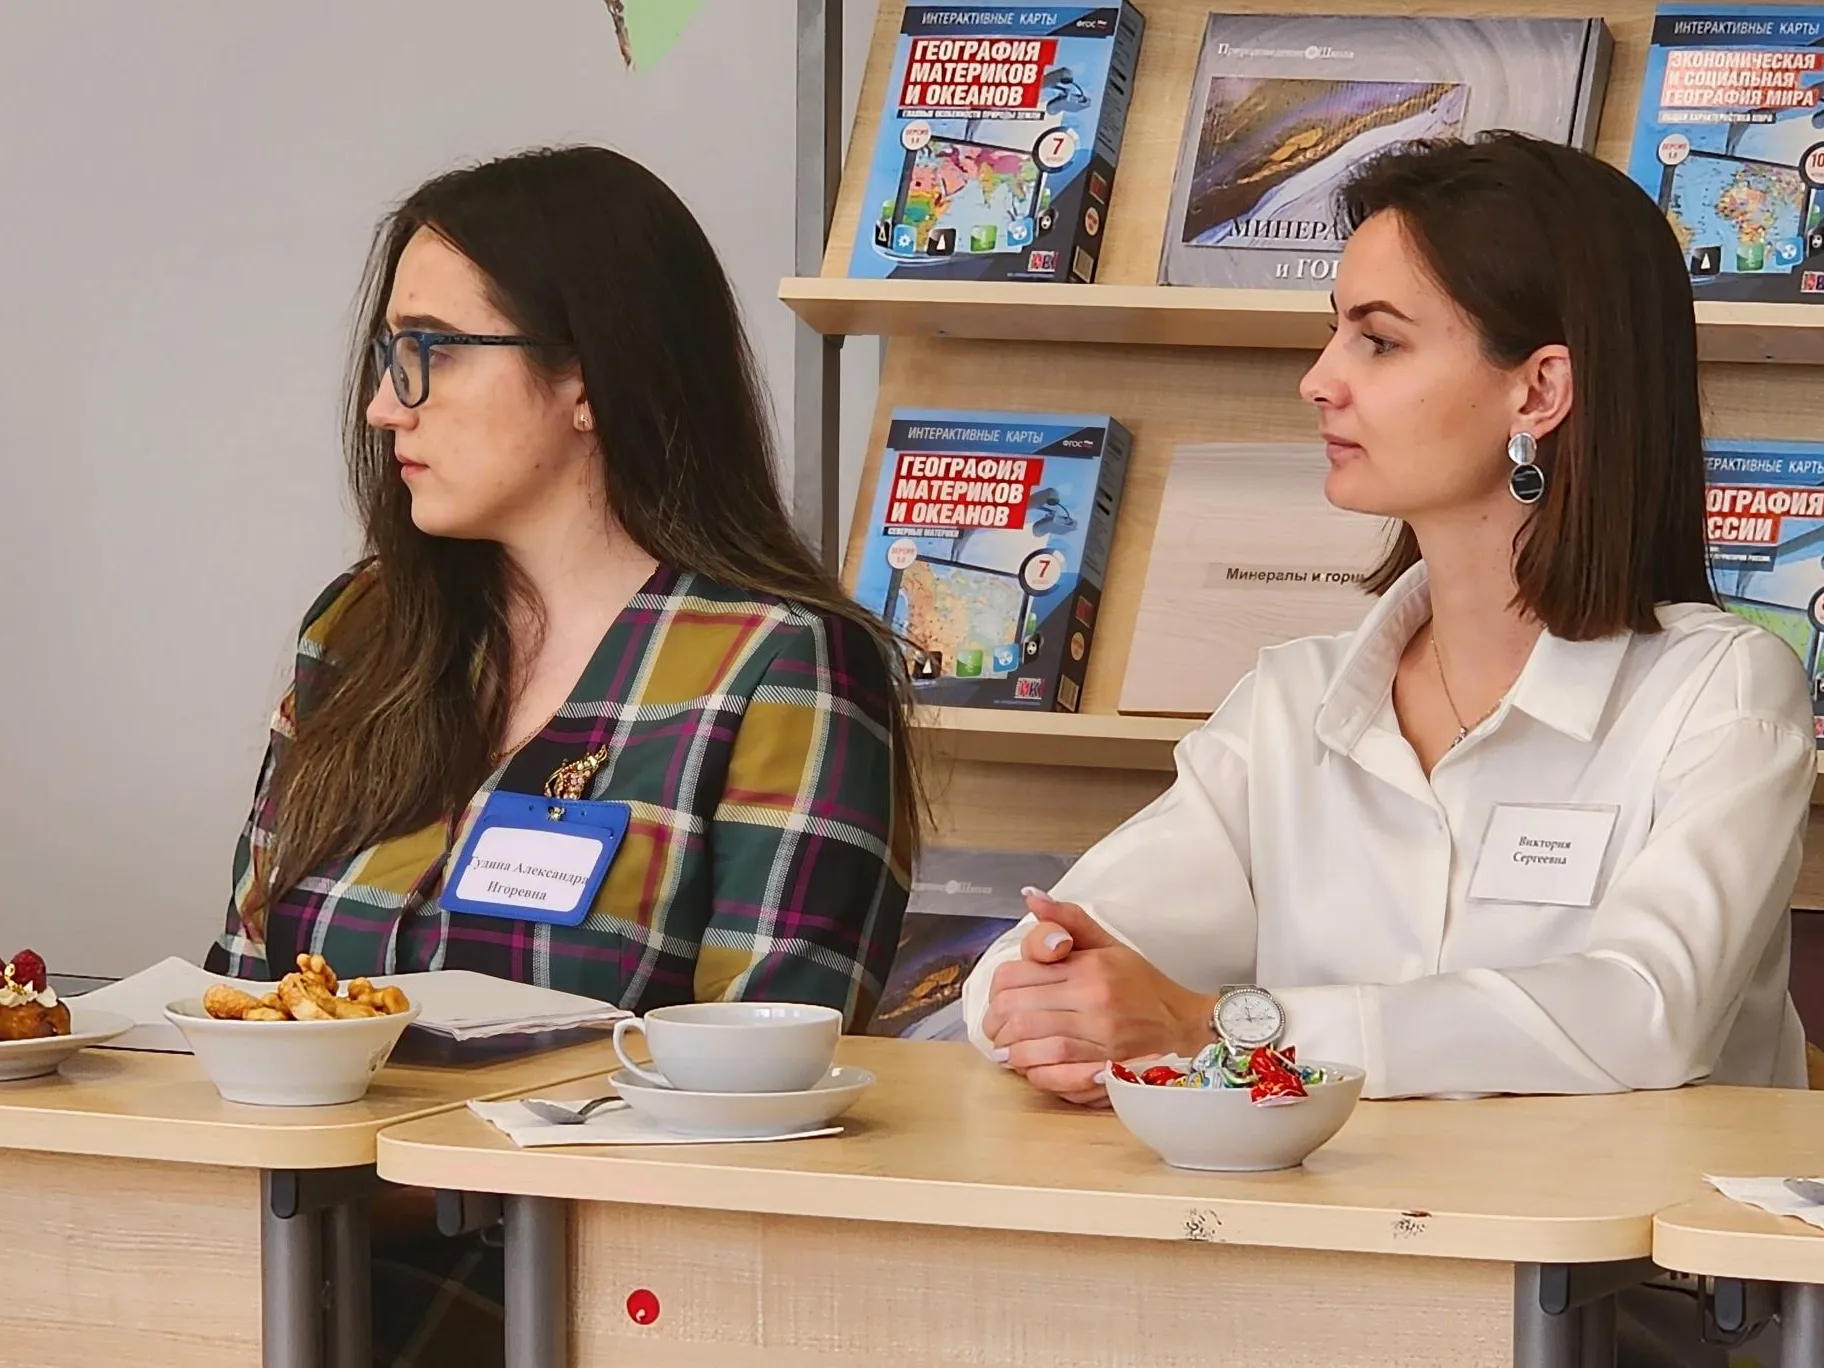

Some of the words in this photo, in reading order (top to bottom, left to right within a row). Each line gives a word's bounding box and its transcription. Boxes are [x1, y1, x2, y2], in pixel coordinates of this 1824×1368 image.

[922, 12, 1014, 25] ИНТЕРАКТИВНЫЕ
[1019, 13, 1057, 25] КАРТЫ
[1674, 22, 1774, 35] ИНТЕРАКТИВНЫЕ
[1779, 22, 1820, 35] КАРТЫ
[914, 40, 1041, 62] ГЕОГРАФИЯ
[1671, 52, 1816, 69] ЭКОНОМИЧЕСКАЯ
[909, 62, 1038, 84] МАТЕРИКОВ
[1668, 71, 1680, 85] И
[1684, 71, 1795, 88] СОЦИАЛЬНАЯ
[905, 85, 920, 105] И
[925, 84, 1023, 107] ОКЕАНОВ
[1665, 89, 1762, 105] ГЕОГРАФИЯ
[1766, 90, 1814, 106] МИРА
[1053, 138, 1064, 155] 7
[1276, 263, 1290, 279] и
[908, 427, 1000, 442] ИНТЕРАКТИВНЫЕ
[1006, 431, 1044, 443] КАРТЫ
[1062, 440, 1083, 448] ФГОС
[900, 456, 1027, 480] ГЕОГРАФИЯ
[1704, 457, 1783, 472] ЕРАКТИВНЫЕ
[895, 480, 1024, 504] МАТЕРИКОВ
[891, 503, 906, 522] И
[912, 503, 1010, 526] ОКЕАНОВ
[1039, 560, 1050, 578] 7
[1226, 568, 1308, 583] Минералы
[1312, 572, 1320, 582] и
[1518, 836, 1571, 851] Виктория
[1513, 851, 1567, 865] Сергеевна
[487, 880, 547, 900] Игоревна
